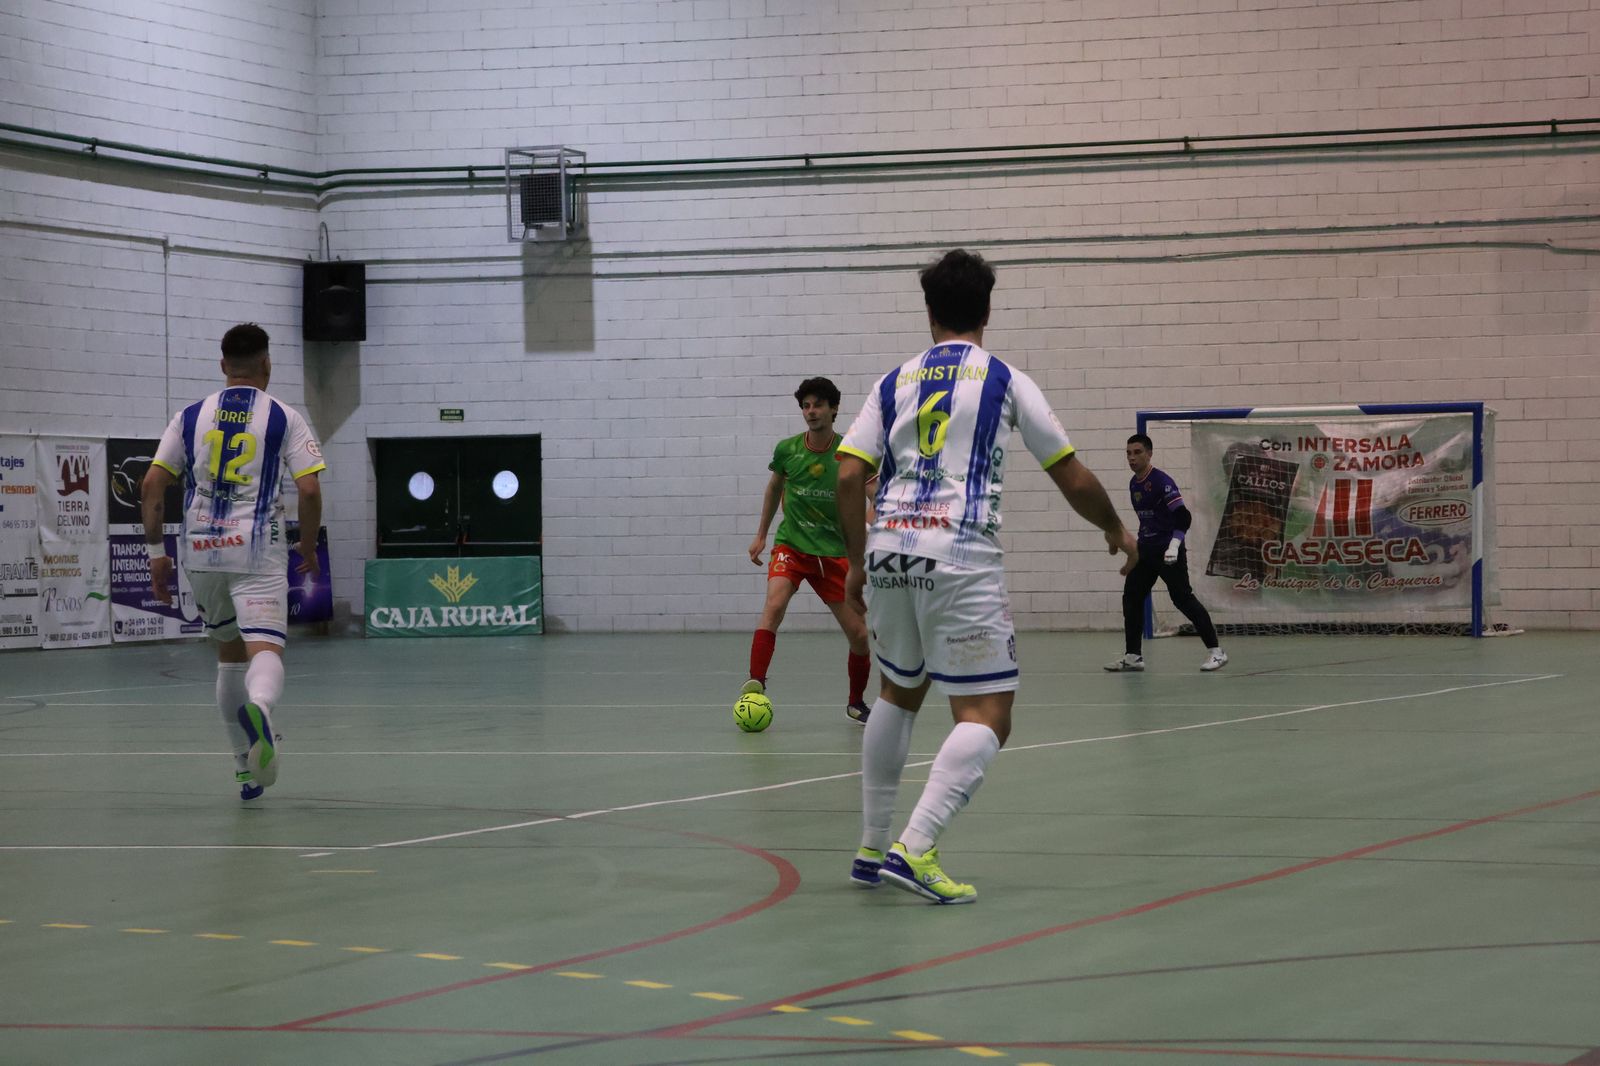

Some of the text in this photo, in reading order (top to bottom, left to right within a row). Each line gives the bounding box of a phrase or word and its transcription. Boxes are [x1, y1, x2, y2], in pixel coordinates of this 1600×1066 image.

[896, 365, 989, 388] CHRISTIAN
[214, 408, 255, 423] JORGE
[917, 391, 951, 459] 6
[1259, 434, 1411, 453] Con INTERSALA
[203, 429, 257, 484] 12
[1333, 452, 1424, 472] ZAMORA
[1237, 475, 1286, 490] CALLOS
[57, 501, 89, 511] TIERRA
[1408, 503, 1467, 520] FERRERO
[884, 515, 951, 529] MACIAS
[111, 543, 148, 556] TRANSPO
[192, 535, 245, 552] MACIAS
[1263, 538, 1429, 565] CASASECA
[112, 572, 151, 583] DE VEHICULO
[1235, 573, 1259, 590] La
[1263, 575, 1318, 592] boutique
[1325, 575, 1343, 589] de
[1347, 575, 1362, 589] la
[370, 604, 537, 629] CAJA RURAL
